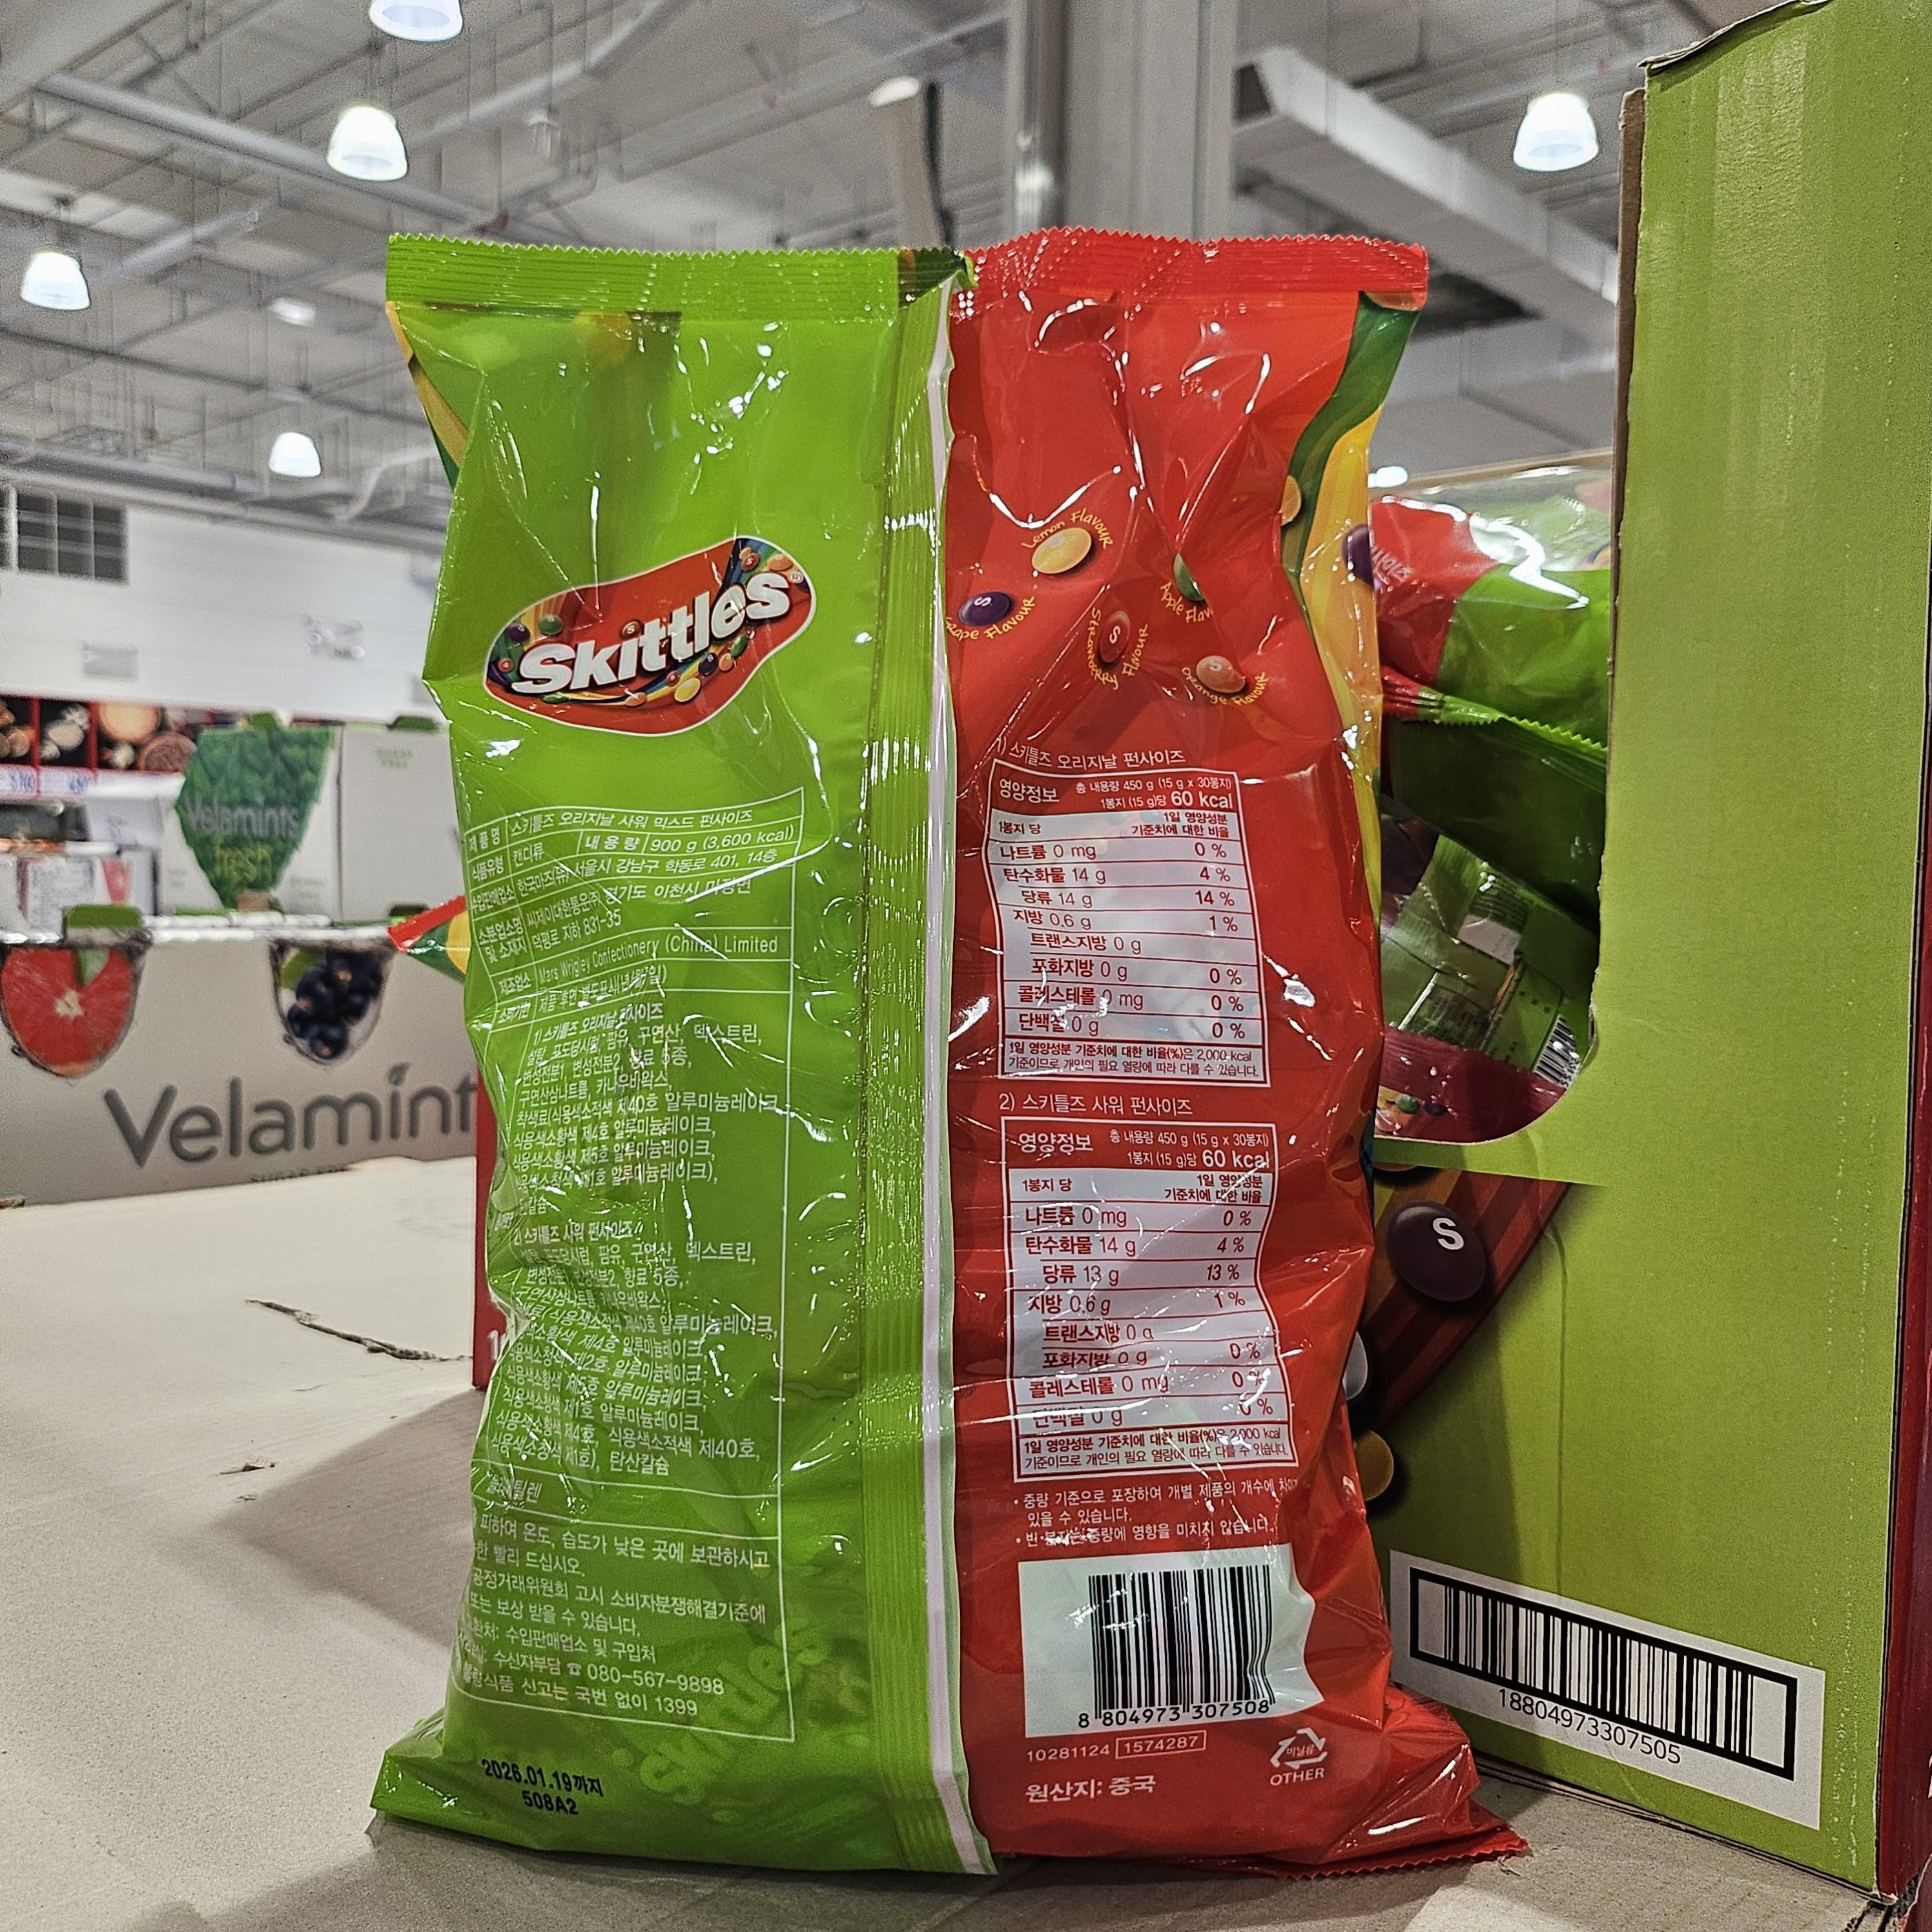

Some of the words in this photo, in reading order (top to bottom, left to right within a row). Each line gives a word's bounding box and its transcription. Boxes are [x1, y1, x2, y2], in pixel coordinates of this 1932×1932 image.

[1021, 521, 1065, 548] Lemon
[511, 573, 792, 694] Skittles
[1009, 742, 1053, 767] 스키틀즈
[1057, 754, 1117, 770] 오리지날
[1123, 749, 1186, 768] 펀사이즈
[1000, 778, 1060, 804] 영양정보
[1089, 779, 1120, 793] 내용량
[1123, 779, 1144, 791] 450
[1170, 791, 1193, 807] 60
[1198, 791, 1233, 810] kcal
[511, 814, 555, 836] 스키틀즈
[559, 812, 615, 827] 오리지날
[618, 815, 649, 830] 사워
[654, 817, 695, 830] 믹스드
[700, 810, 754, 829] 펀사이즈
[998, 821, 1025, 835] 1봉지
[1184, 812, 1228, 825] 영양성분
[650, 838, 682, 852] 900
[703, 832, 752, 851] (3,600
[757, 824, 794, 844] kcal)
[1131, 824, 1178, 836] 기준치에
[513, 842, 544, 868] 캔디류
[574, 857, 611, 878] 서울시
[616, 858, 659, 874] 강남구
[665, 856, 706, 874] 학동로
[710, 853, 739, 869] 401,
[747, 848, 777, 864] 14층
[1000, 845, 1047, 861] 나트륨
[1071, 845, 1096, 861] mg
[1003, 867, 1065, 883] 탄수화물
[1072, 867, 1089, 882] 14
[654, 880, 699, 898] 이천시
[1021, 890, 1053, 905] 당류
[1058, 892, 1076, 906] 14
[1195, 890, 1215, 905] 14
[1012, 909, 1043, 925] 지방
[1049, 912, 1075, 928] 0.6
[1030, 932, 1107, 951] 트랜스지방
[560, 956, 590, 976] Wrigley
[592, 939, 659, 968] Confectionery
[666, 934, 718, 954] (China)
[724, 936, 778, 953] Limited
[1031, 958, 1094, 978] 포화지방
[1018, 985, 1096, 1005] 콜레스테롤
[1118, 993, 1144, 1011] mg
[542, 1021, 579, 1042] 스키틀즈
[579, 1012, 616, 1034] 오리지날
[1029, 1042, 1072, 1056] 영양성분
[1076, 1044, 1118, 1058] 기준치에
[1122, 1045, 1143, 1059] 대한
[1147, 1047, 1194, 1060] 비율(%)은
[1231, 1051, 1251, 1062] kcal
[1009, 1056, 1059, 1070] 기준이므로
[1122, 1060, 1153, 1074] 열량에
[999, 1091, 1016, 1112] 2)
[1022, 1093, 1087, 1113] 스키틀즈
[1092, 1095, 1124, 1115] 사워
[1130, 1096, 1193, 1116] 펀사이즈
[513, 1125, 578, 1150] 식용색소황색
[582, 1122, 609, 1143] 제4호
[1019, 1131, 1094, 1153] 영양정보
[1124, 1129, 1154, 1146] 내용량
[1158, 1131, 1177, 1146] 450
[581, 1144, 609, 1164] 제5호
[1127, 1151, 1153, 1166] 1봉지
[1202, 1149, 1226, 1168] 60
[1231, 1149, 1270, 1169] kcal
[1022, 1178, 1054, 1192] 1봉지
[1164, 1188, 1211, 1202] 기준치에
[1025, 1206, 1075, 1226] 나트륨
[1101, 1211, 1127, 1228] mg
[1025, 1235, 1093, 1255] 탄수화물
[1099, 1236, 1119, 1253] 14
[1432, 1217, 1464, 1251] S
[624, 1267, 648, 1288] 향료
[1042, 1264, 1077, 1284] 당류
[1207, 1264, 1222, 1281] 13
[1028, 1294, 1063, 1315] 지방
[1029, 1375, 1115, 1399] 콜레스테롤
[609, 1426, 692, 1457] 식용색소적색
[699, 1437, 761, 1462] 제40호,
[1046, 1437, 1094, 1453] 영양성분
[1098, 1434, 1145, 1449] 기준치에
[610, 1451, 669, 1475] 탄산칼슘
[1025, 1454, 1082, 1470] 기준이므로
[1086, 1451, 1120, 1466] 개인의
[1124, 1450, 1147, 1464] 필요
[1023, 1492, 1049, 1509] 중량
[1055, 1490, 1106, 1506] 기준으로
[1111, 1485, 1162, 1503] 포장하여
[1168, 1483, 1193, 1500] 개별
[1199, 1481, 1237, 1499] 제품의
[1241, 1477, 1275, 1495] 개수에
[1028, 1510, 1054, 1528] 있을
[1078, 1506, 1132, 1525] 있습니다.
[480, 1513, 517, 1539] 피하여
[522, 1522, 555, 1550] 온도,
[562, 1530, 608, 1555] 습도가
[614, 1536, 646, 1559] 낮은
[652, 1539, 684, 1563] 곳에
[691, 1544, 771, 1570] 보관하시고
[1132, 1522, 1171, 1541] 영향을
[526, 1551, 585, 1577] 드십시오.
[473, 1566, 569, 1601] 공정거래위원회
[575, 1585, 604, 1606] 고시
[611, 1590, 766, 1625] 소비자분쟁해결기준에
[497, 1598, 524, 1620] 보상
[529, 1602, 556, 1626] 받을
[581, 1610, 641, 1638] 있습니다.
[506, 1625, 588, 1652] 수입판매업소
[613, 1641, 657, 1665] 구입처
[493, 1649, 562, 1676] 수신자부담
[587, 1663, 725, 1696] 080-567-9898
[522, 1678, 570, 1701] 신고는
[615, 1690, 648, 1712] 없이
[655, 1695, 699, 1717] 1399
[1102, 1705, 1182, 1727] 804973
[1192, 1699, 1271, 1721] 307508
[1498, 1687, 1682, 1766] 18804973307505
[1026, 1743, 1111, 1763] 10281124
[1124, 1734, 1200, 1755] 1574287
[480, 1758, 604, 1798] 2026.01.19까지
[1269, 1767, 1325, 1787] OTHER
[1025, 1779, 1103, 1804] 원산지:
[1109, 1774, 1157, 1796] 중국
[521, 1789, 579, 1816] 508A2
